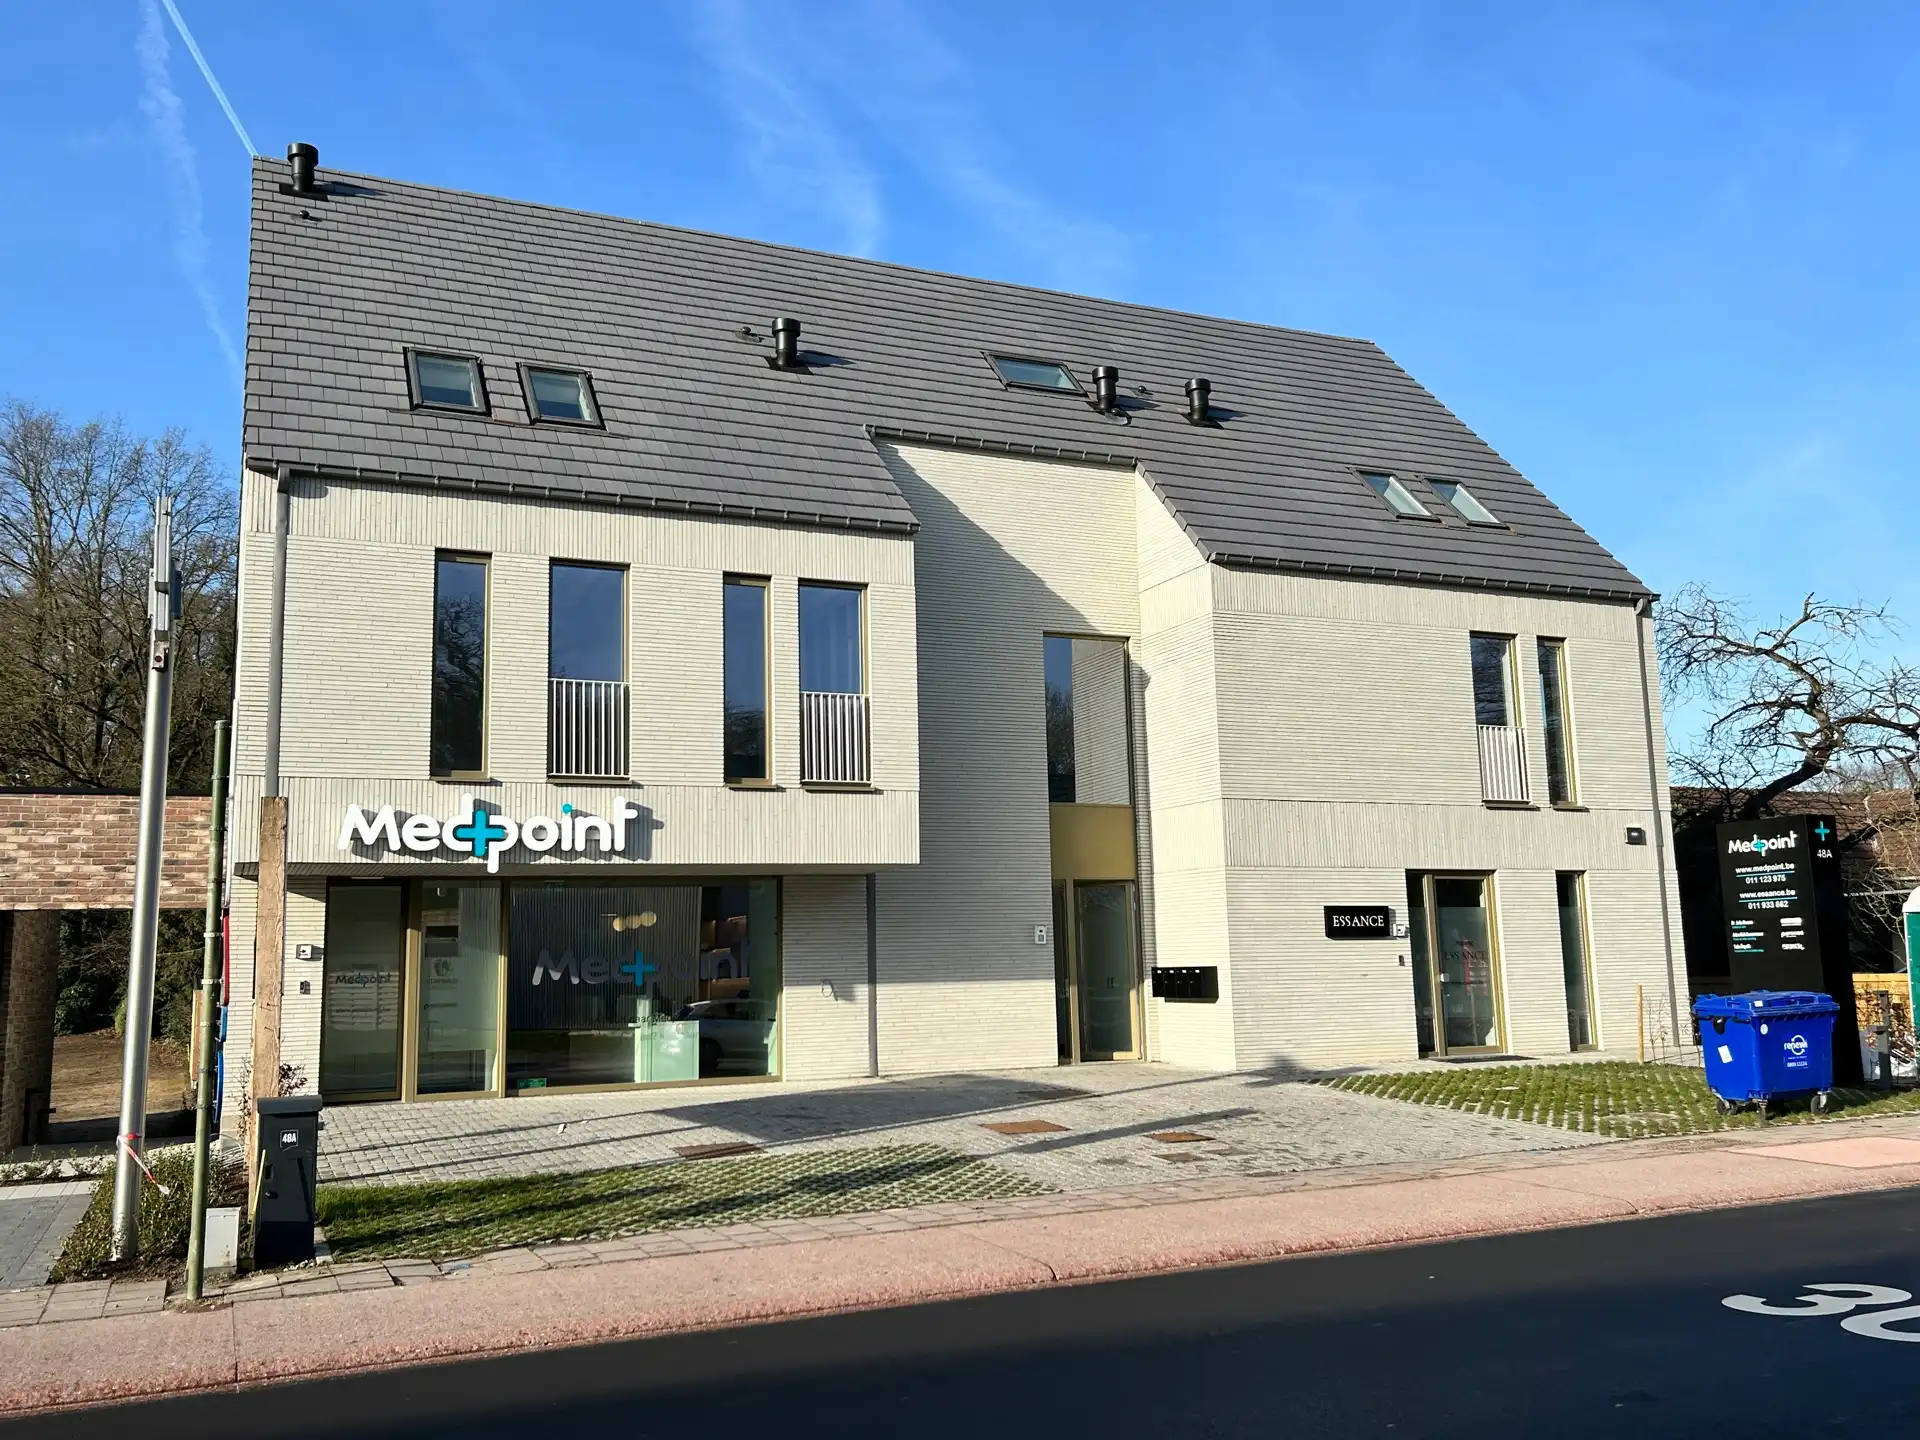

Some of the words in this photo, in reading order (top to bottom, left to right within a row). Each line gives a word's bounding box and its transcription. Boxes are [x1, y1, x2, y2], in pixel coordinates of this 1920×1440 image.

[337, 793, 638, 874] Medpoint
[1728, 830, 1797, 857] Medpoint
[1816, 849, 1833, 858] 48A
[1735, 862, 1795, 874] www.medpoint.be
[1745, 876, 1758, 884] 011
[1760, 875, 1772, 883] 123
[1773, 874, 1786, 882] 975
[1739, 888, 1796, 899] www.essance.be
[1748, 902, 1760, 910] 011
[1761, 901, 1775, 909] 933
[1332, 915, 1385, 927] ESSANCE
[335, 972, 393, 988] Medpoint
[282, 1132, 297, 1143] 48A
